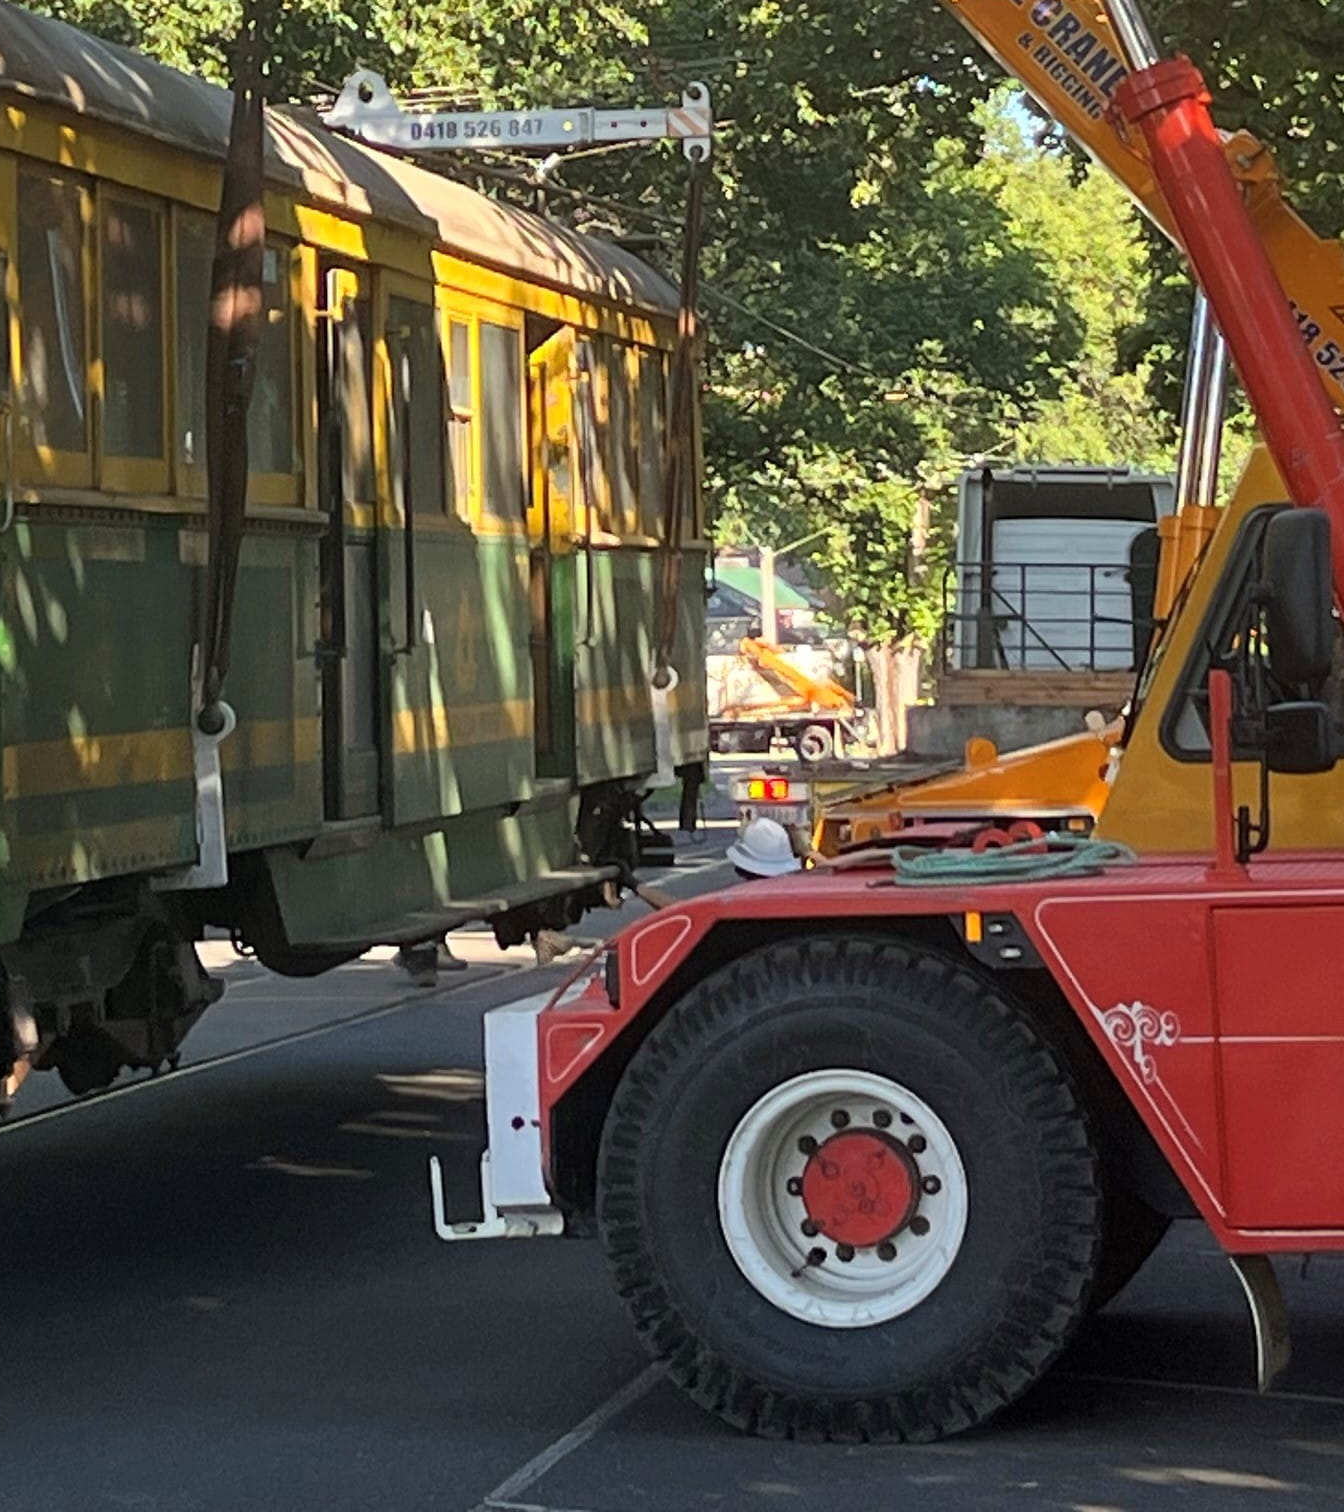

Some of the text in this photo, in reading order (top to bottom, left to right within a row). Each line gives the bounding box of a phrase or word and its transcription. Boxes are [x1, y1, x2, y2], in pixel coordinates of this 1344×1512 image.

[1017, 32, 1103, 120] & RIGGING
[411, 118, 543, 141] 0418 526 847
